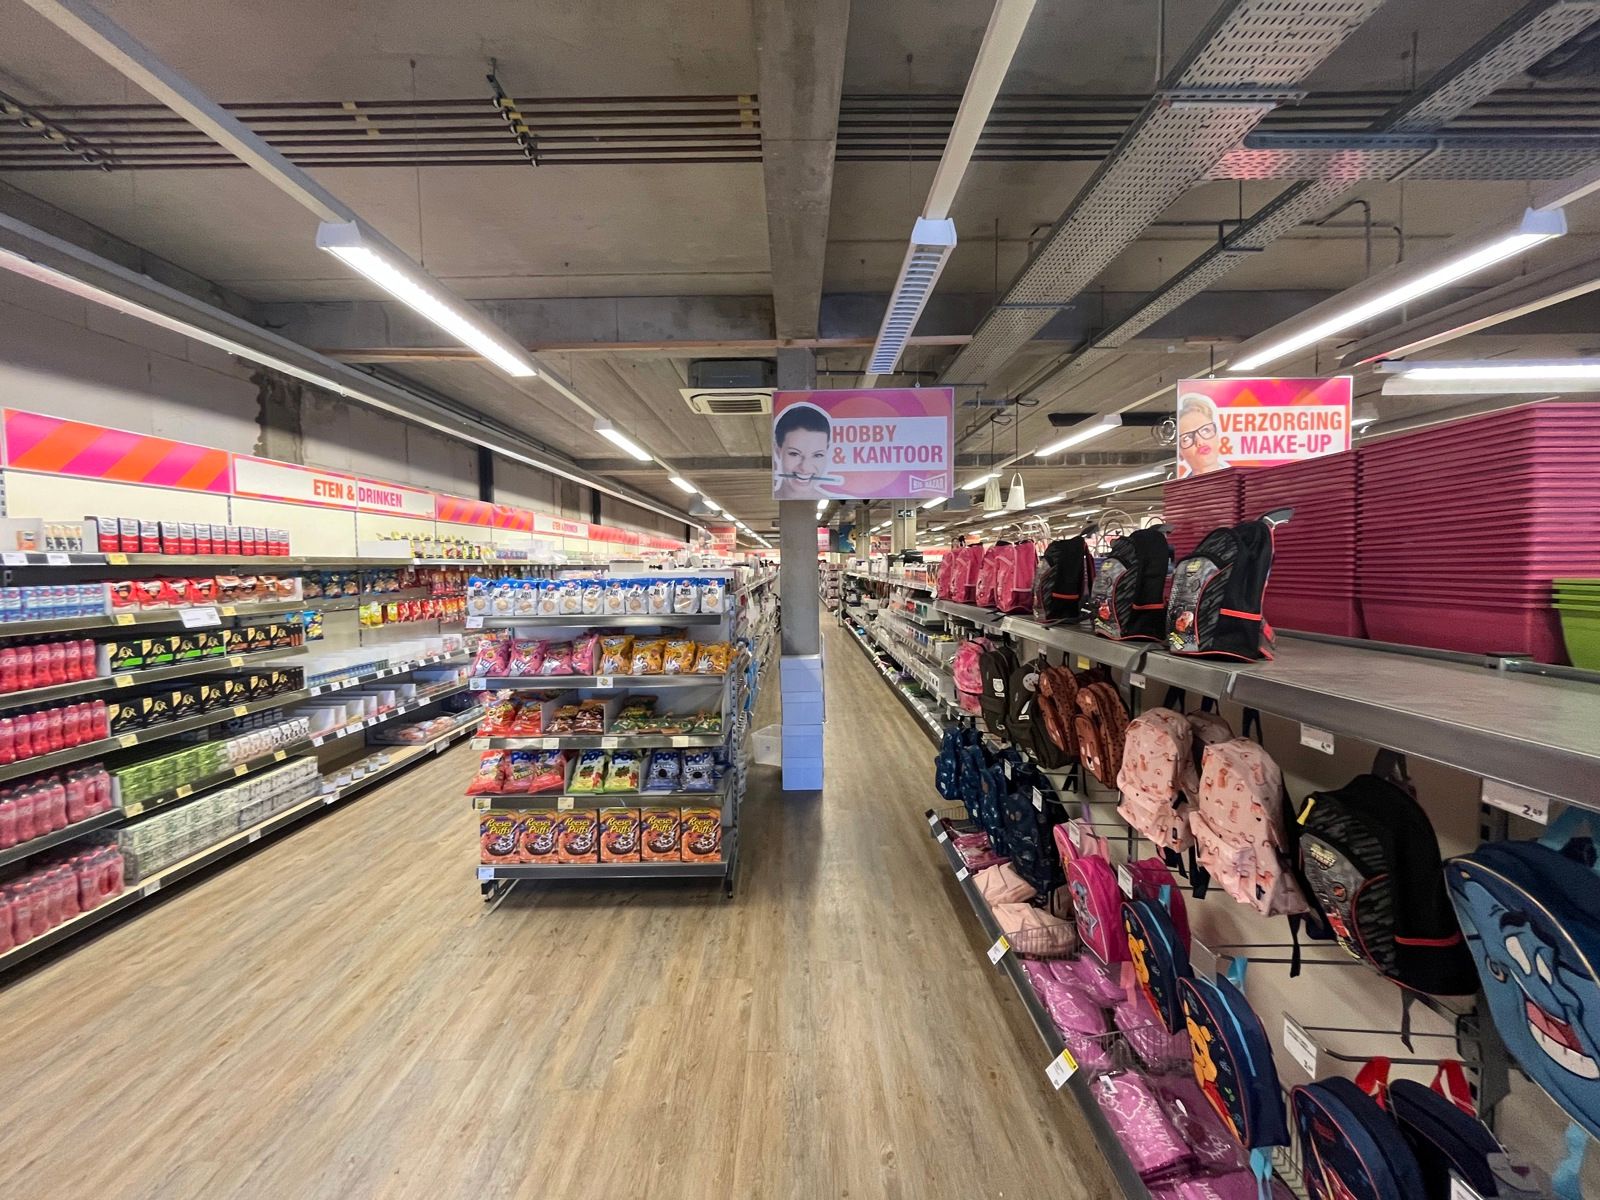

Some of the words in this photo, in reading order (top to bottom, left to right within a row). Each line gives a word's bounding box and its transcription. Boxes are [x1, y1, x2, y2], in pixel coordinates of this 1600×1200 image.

[1219, 411, 1342, 433] VERZORGING
[832, 424, 897, 443] HOBBY
[1218, 436, 1233, 455] &
[1240, 434, 1332, 455] MAKE-UP
[832, 447, 846, 464] &
[853, 445, 943, 464] KANTOOR
[313, 479, 343, 499] ETEN
[346, 484, 355, 501] &
[358, 486, 403, 508] DRINKEN
[654, 752, 678, 763] POP
[685, 752, 709, 766] POP
[489, 824, 511, 835] Puffs
[528, 824, 550, 834] Puffs
[567, 824, 589, 834] Puffs
[610, 824, 631, 834] Puffs
[650, 822, 672, 832] Puffs
[691, 823, 713, 833] Puffs
